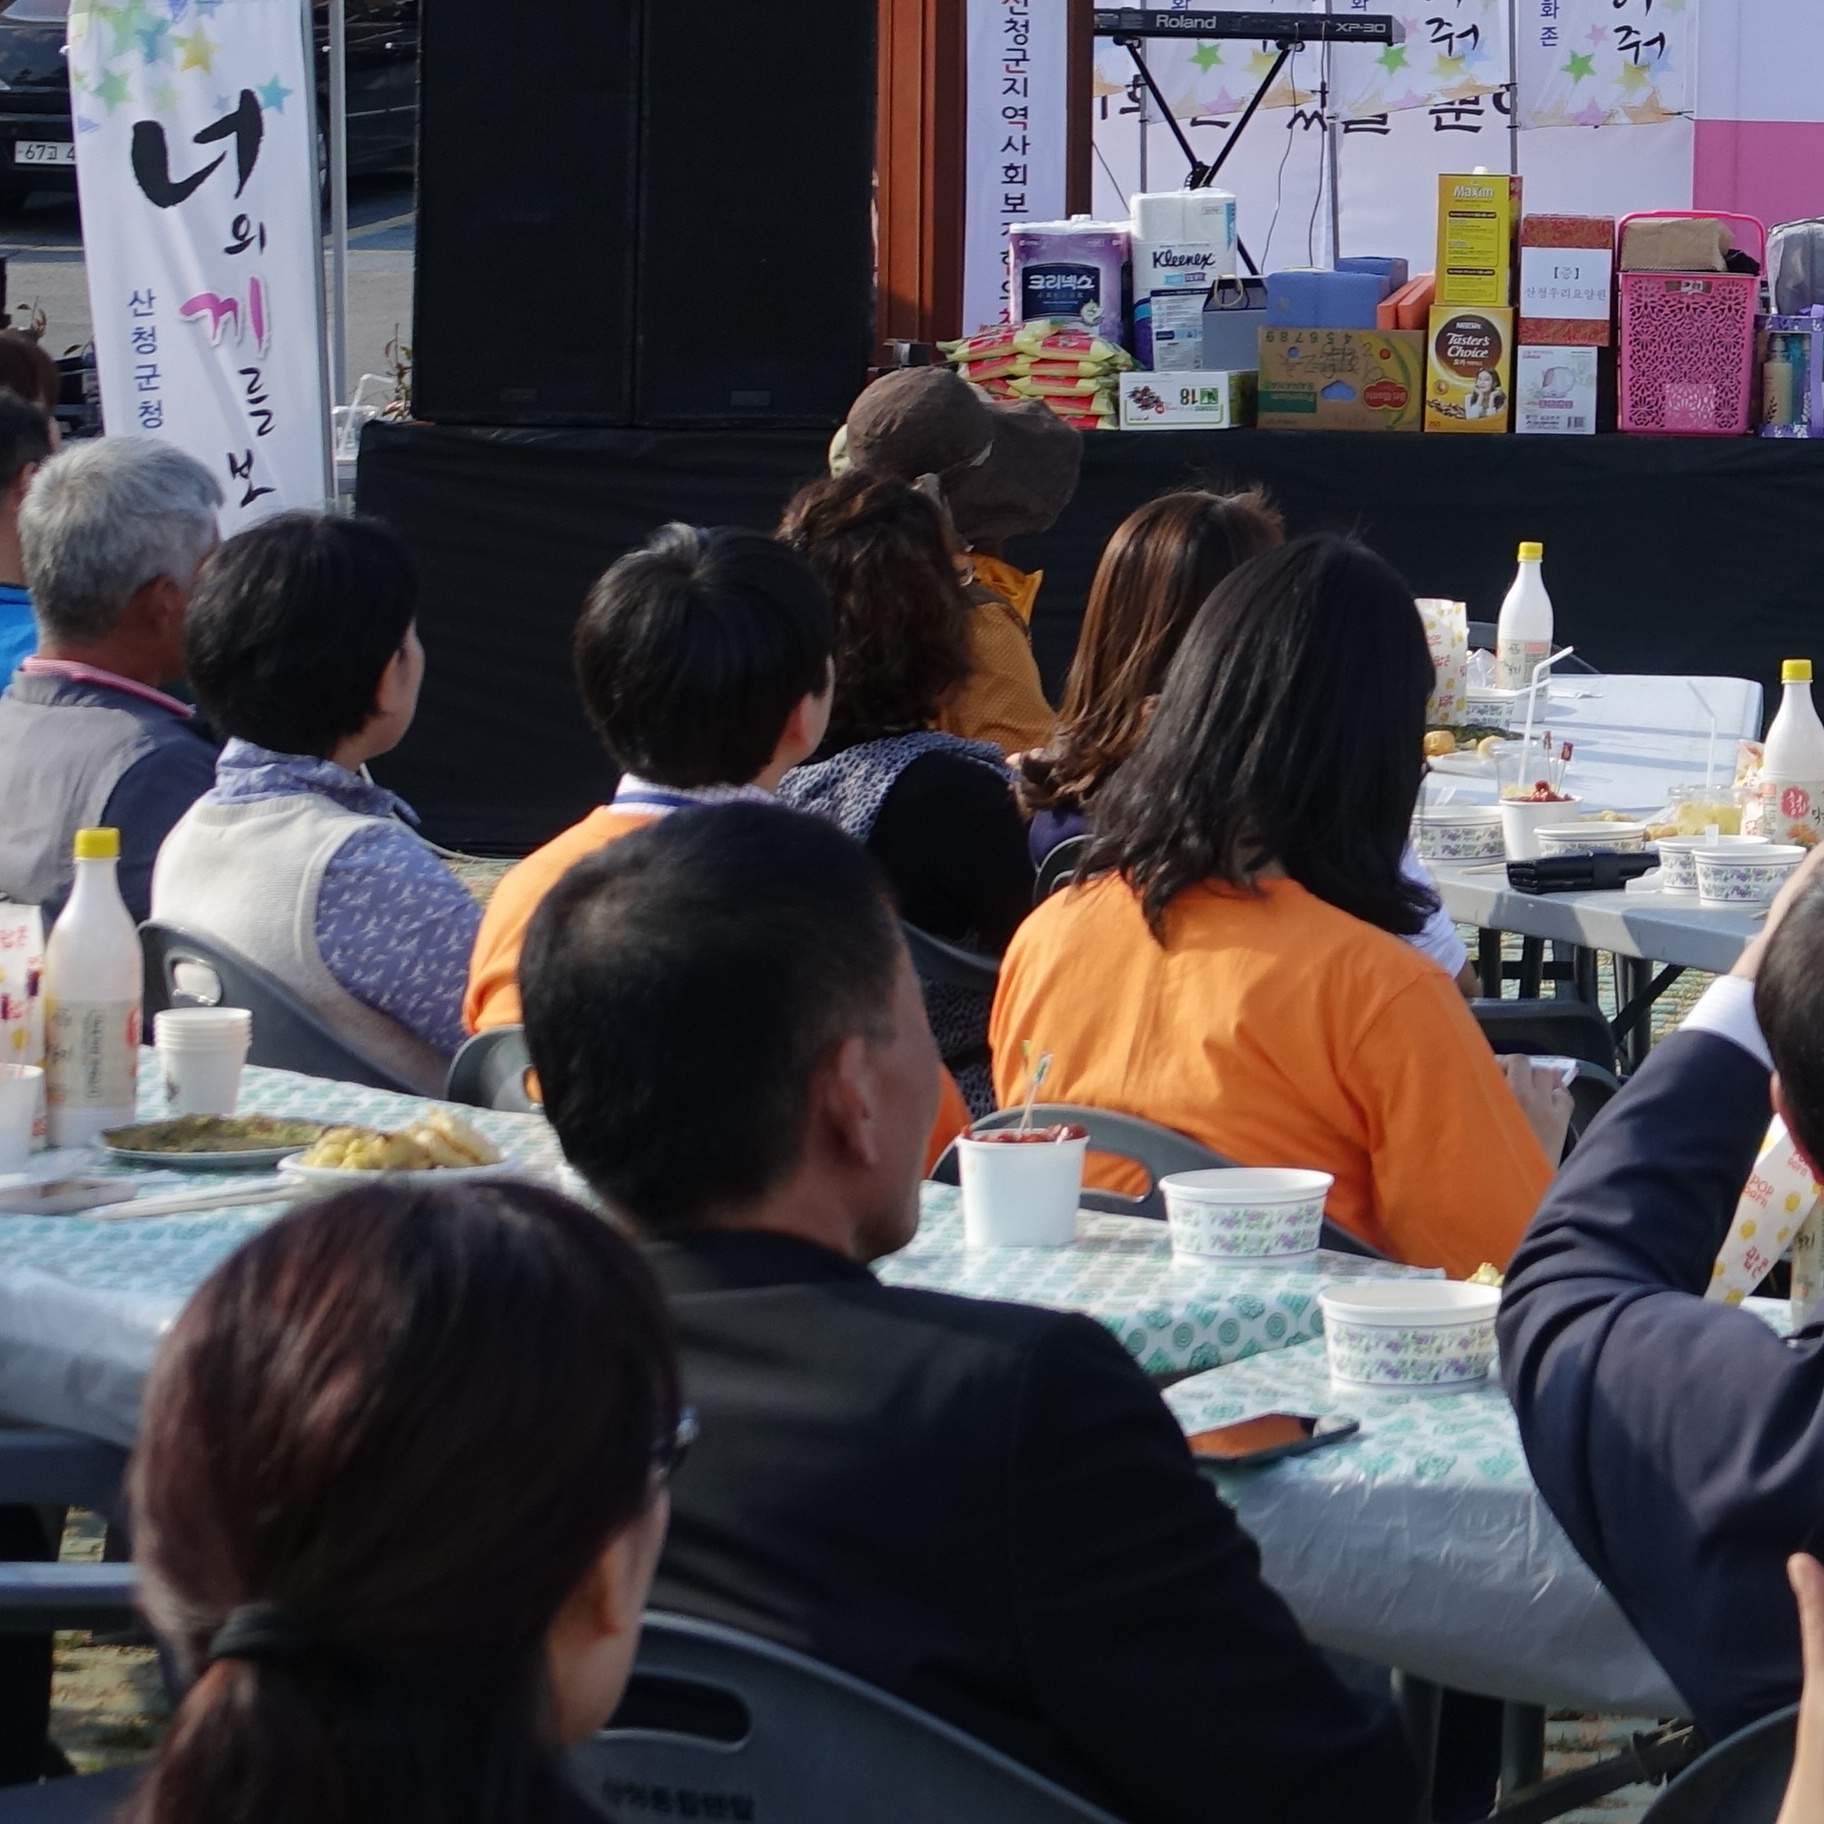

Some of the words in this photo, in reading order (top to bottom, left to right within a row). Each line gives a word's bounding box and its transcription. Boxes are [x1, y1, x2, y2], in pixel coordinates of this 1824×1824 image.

[1156, 14, 1217, 30] Roland
[1335, 22, 1387, 33] XP-30
[131, 88, 267, 255] 너의
[1454, 185, 1494, 198] Maxim
[1152, 249, 1216, 270] Kleenex
[1028, 274, 1095, 290] 크리넥스
[1447, 332, 1491, 346] Taster's
[1447, 345, 1489, 358] Choice
[1750, 1175, 1775, 1196] POP
